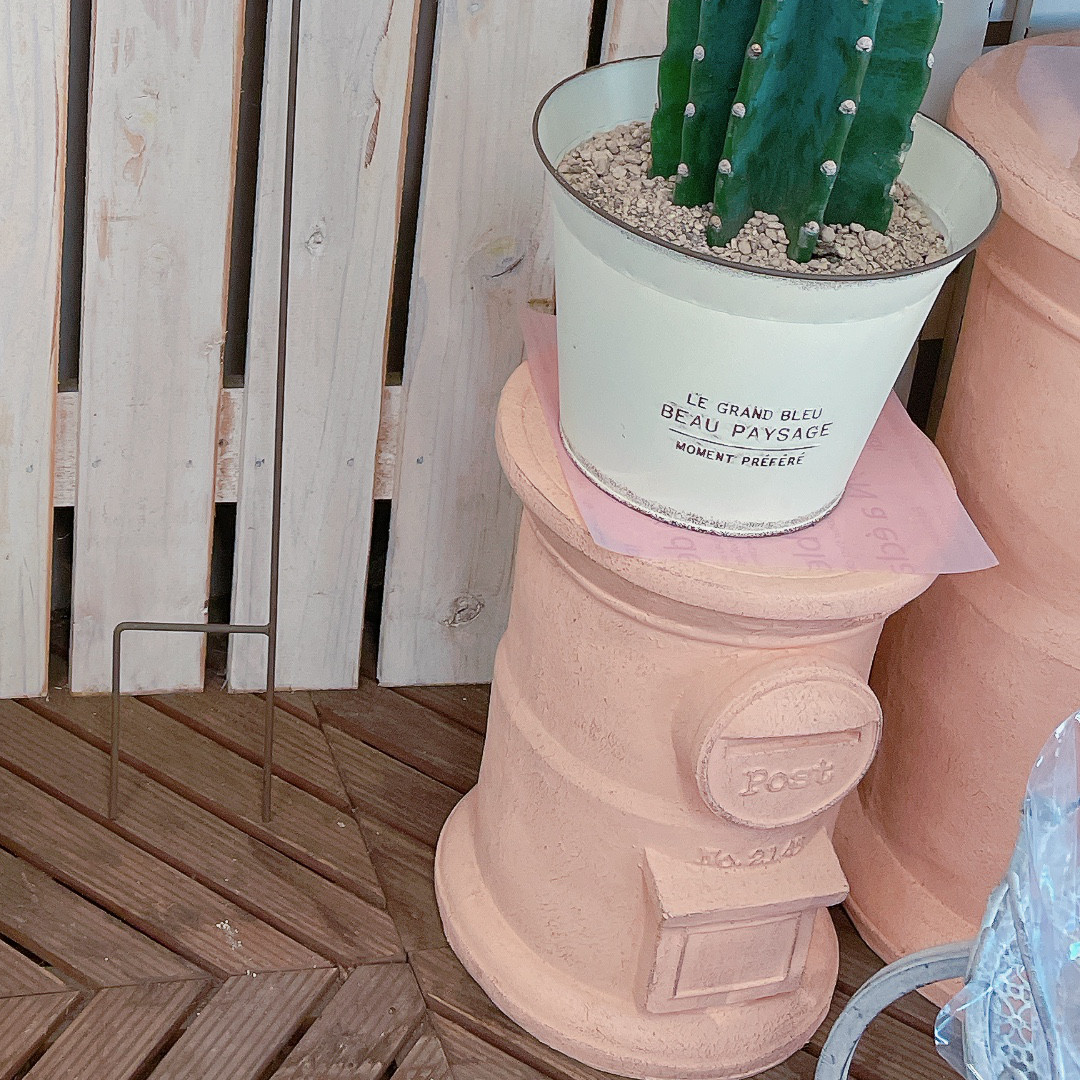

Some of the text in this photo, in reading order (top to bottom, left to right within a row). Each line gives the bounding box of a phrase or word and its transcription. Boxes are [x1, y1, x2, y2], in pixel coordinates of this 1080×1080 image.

[661, 403, 834, 442] BEAU PAYSAGE
[686, 393, 823, 421] LE GRAND BLEU
[675, 440, 805, 467] MOMENT PRÉFÉRÉ
[739, 759, 833, 797] Post
